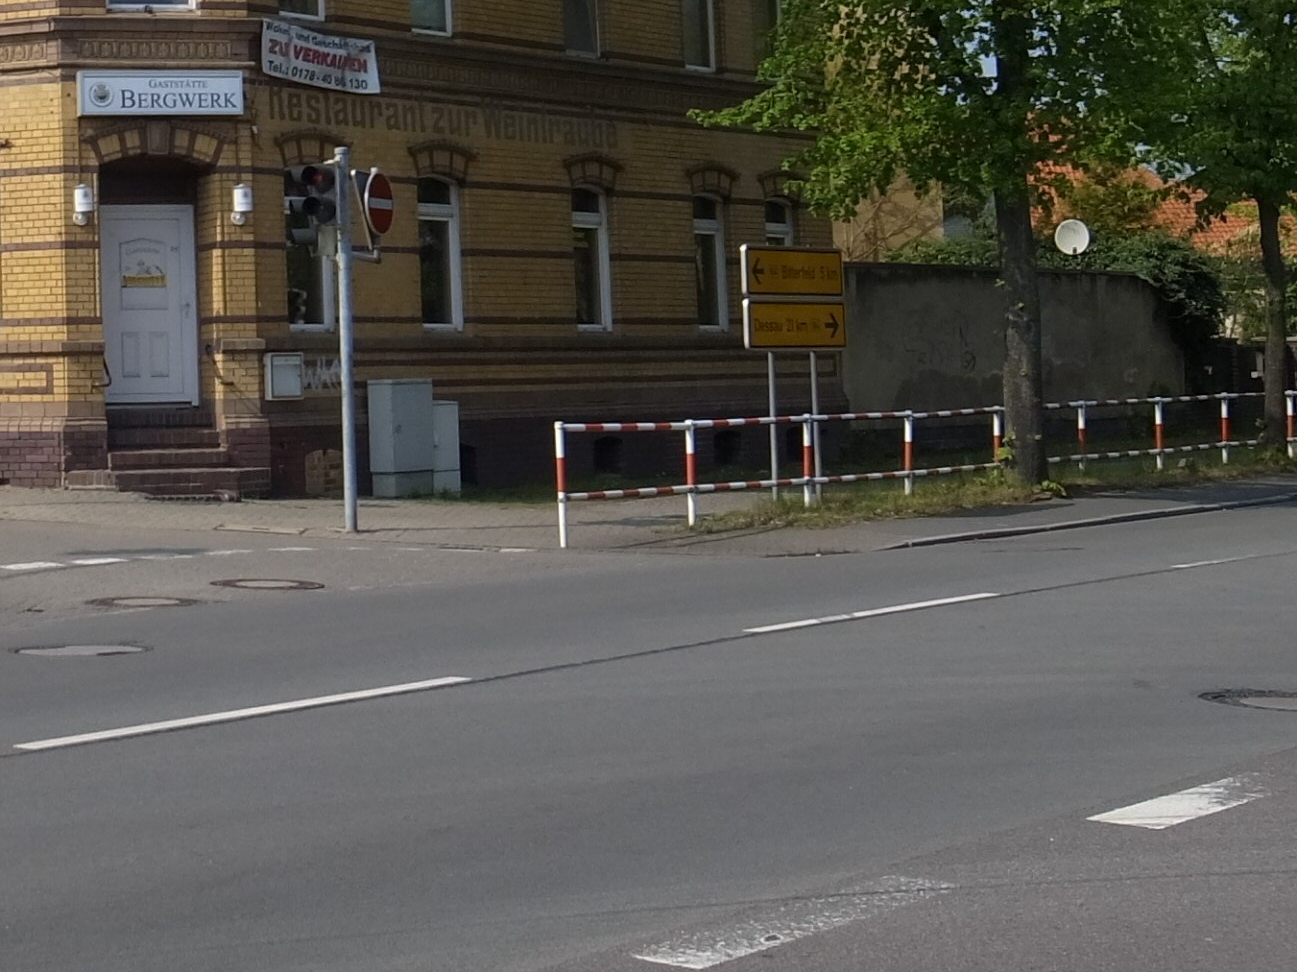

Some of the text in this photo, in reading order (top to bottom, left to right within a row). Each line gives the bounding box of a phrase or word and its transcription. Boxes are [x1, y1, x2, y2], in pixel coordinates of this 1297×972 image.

[268, 38, 289, 57] ZU
[349, 77, 369, 90] 130
[120, 89, 238, 109] BERGWERK
[268, 84, 618, 148] Restaurant zur Weintraube
